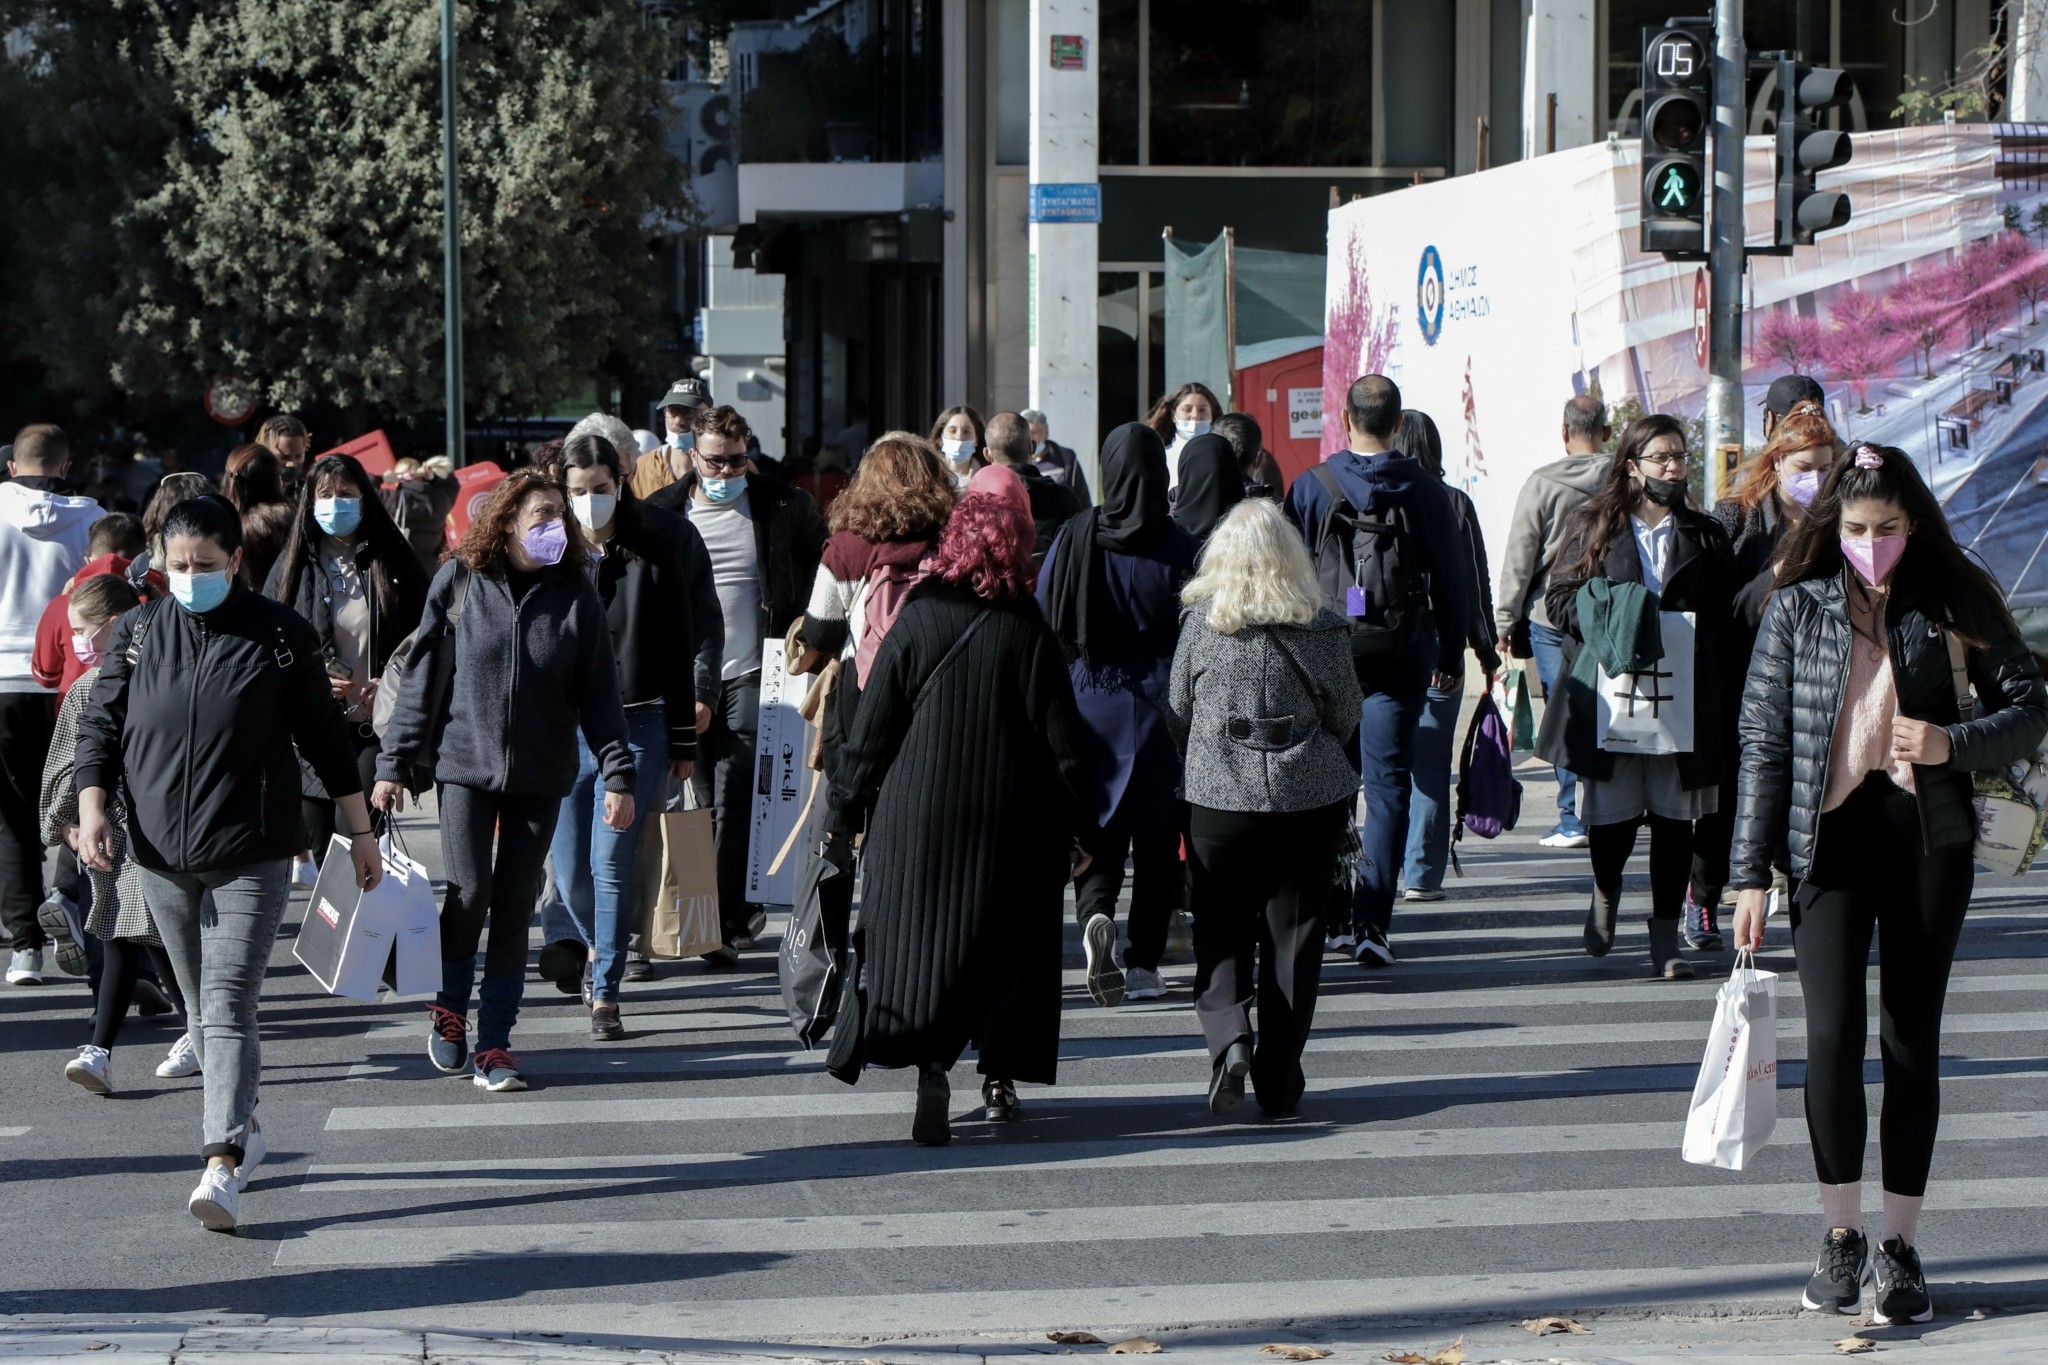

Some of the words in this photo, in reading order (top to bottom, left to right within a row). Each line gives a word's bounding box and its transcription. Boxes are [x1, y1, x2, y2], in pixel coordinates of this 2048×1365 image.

[1657, 42, 1693, 76] 05
[1042, 197, 1096, 207] ΣΥΝΤΑΓΜΑΤΟΣ
[781, 743, 797, 802] arielli
